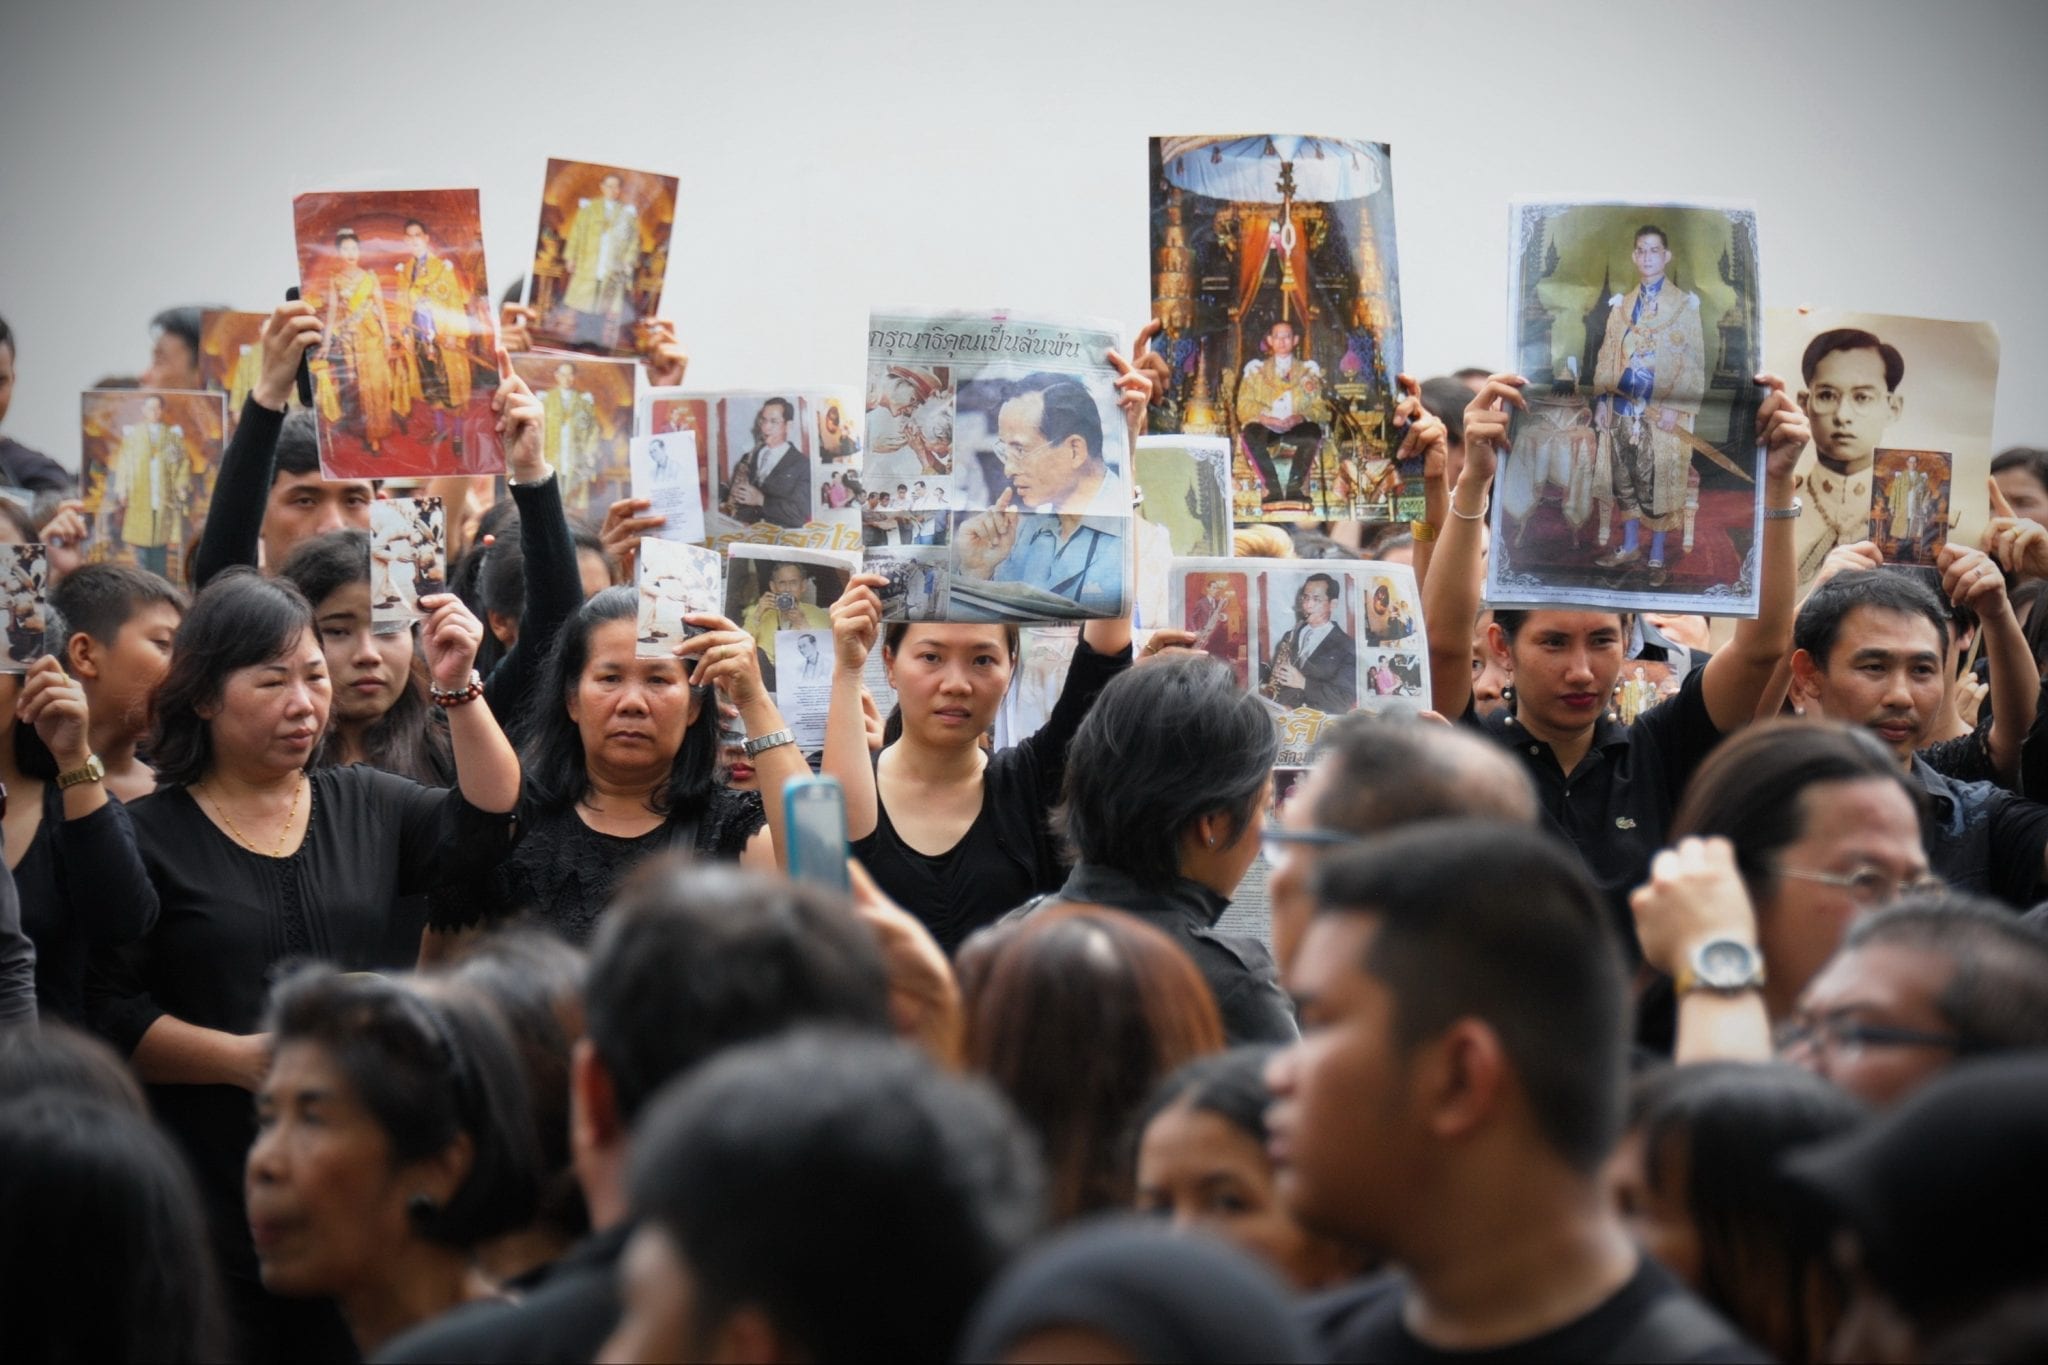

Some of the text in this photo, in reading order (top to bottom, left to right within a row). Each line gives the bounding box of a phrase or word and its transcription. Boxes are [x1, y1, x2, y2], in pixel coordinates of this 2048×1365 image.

[869, 324, 1081, 358] กรุณาธิคุณเป็นล้นพ้น
